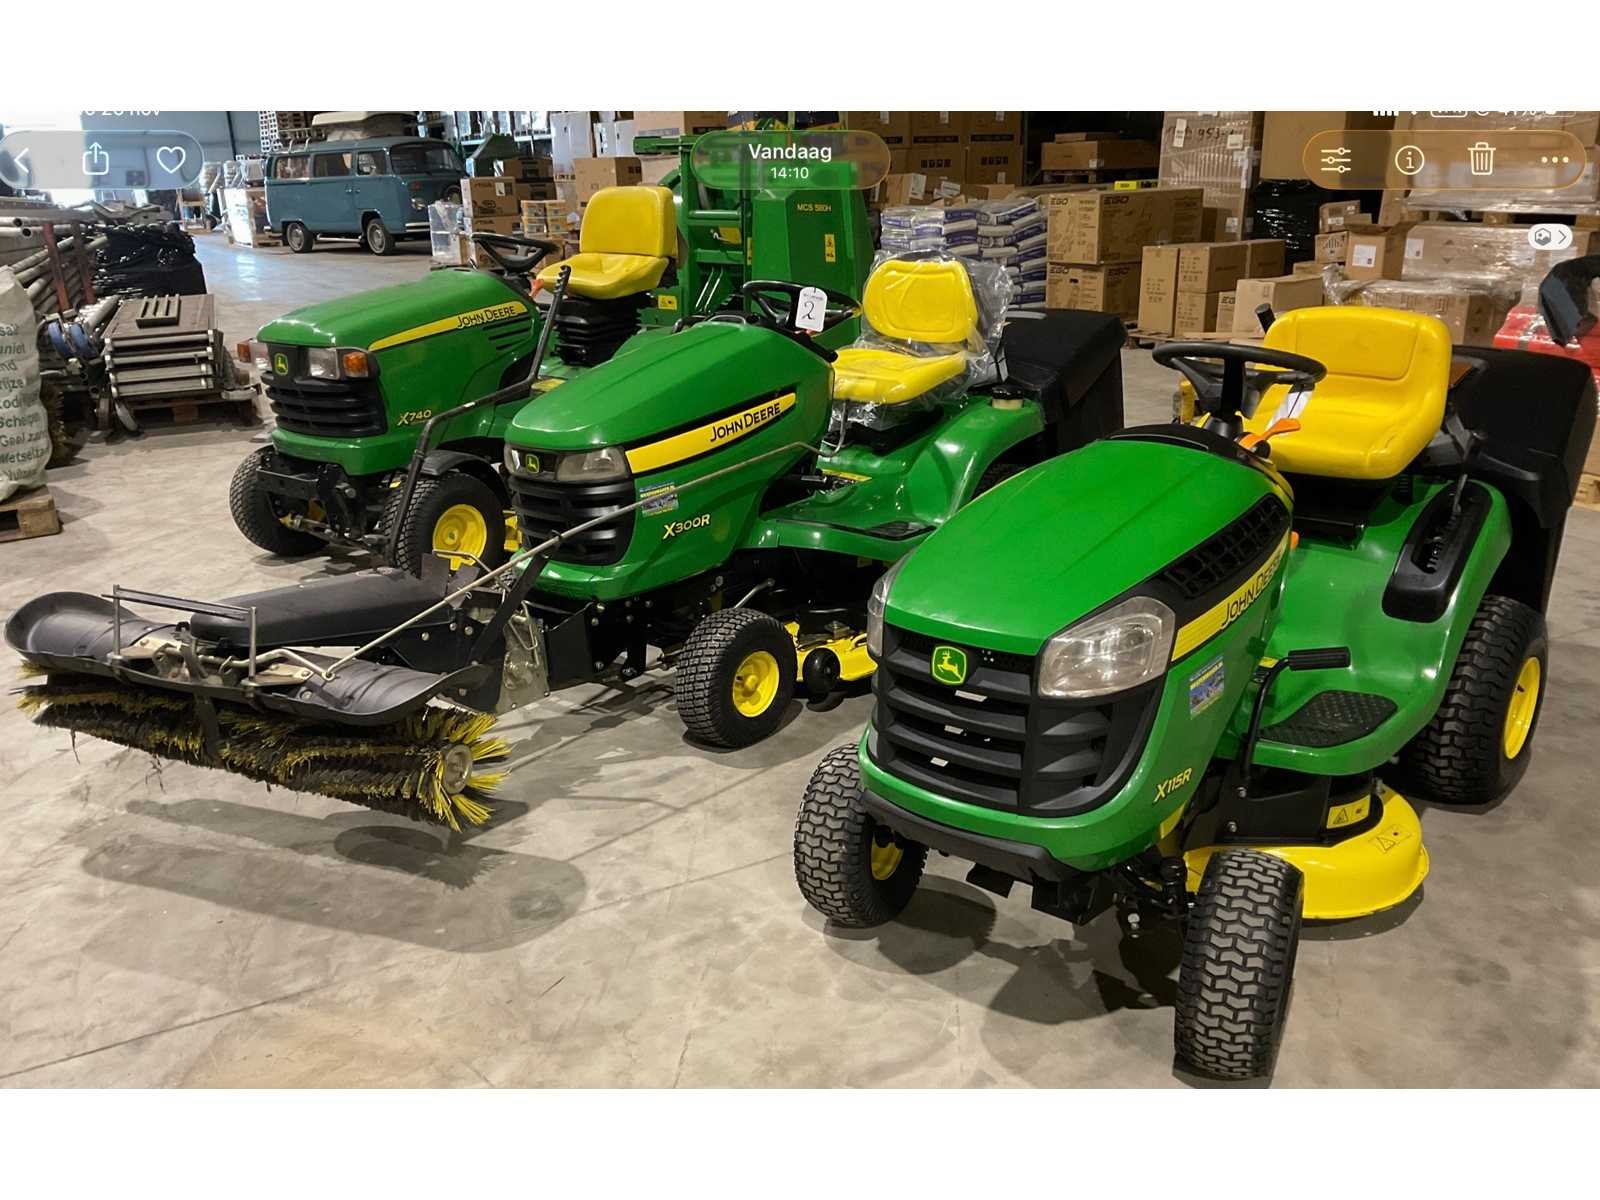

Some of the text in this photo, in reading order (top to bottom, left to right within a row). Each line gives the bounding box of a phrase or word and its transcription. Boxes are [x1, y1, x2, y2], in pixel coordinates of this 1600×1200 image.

[457, 305, 516, 328] JOHN DEERE
[397, 409, 432, 426] X740
[710, 402, 781, 443] JOHN DEERE
[662, 513, 711, 540] X300R
[1221, 583, 1254, 627] JOHN
[1153, 768, 1192, 802] X115R
